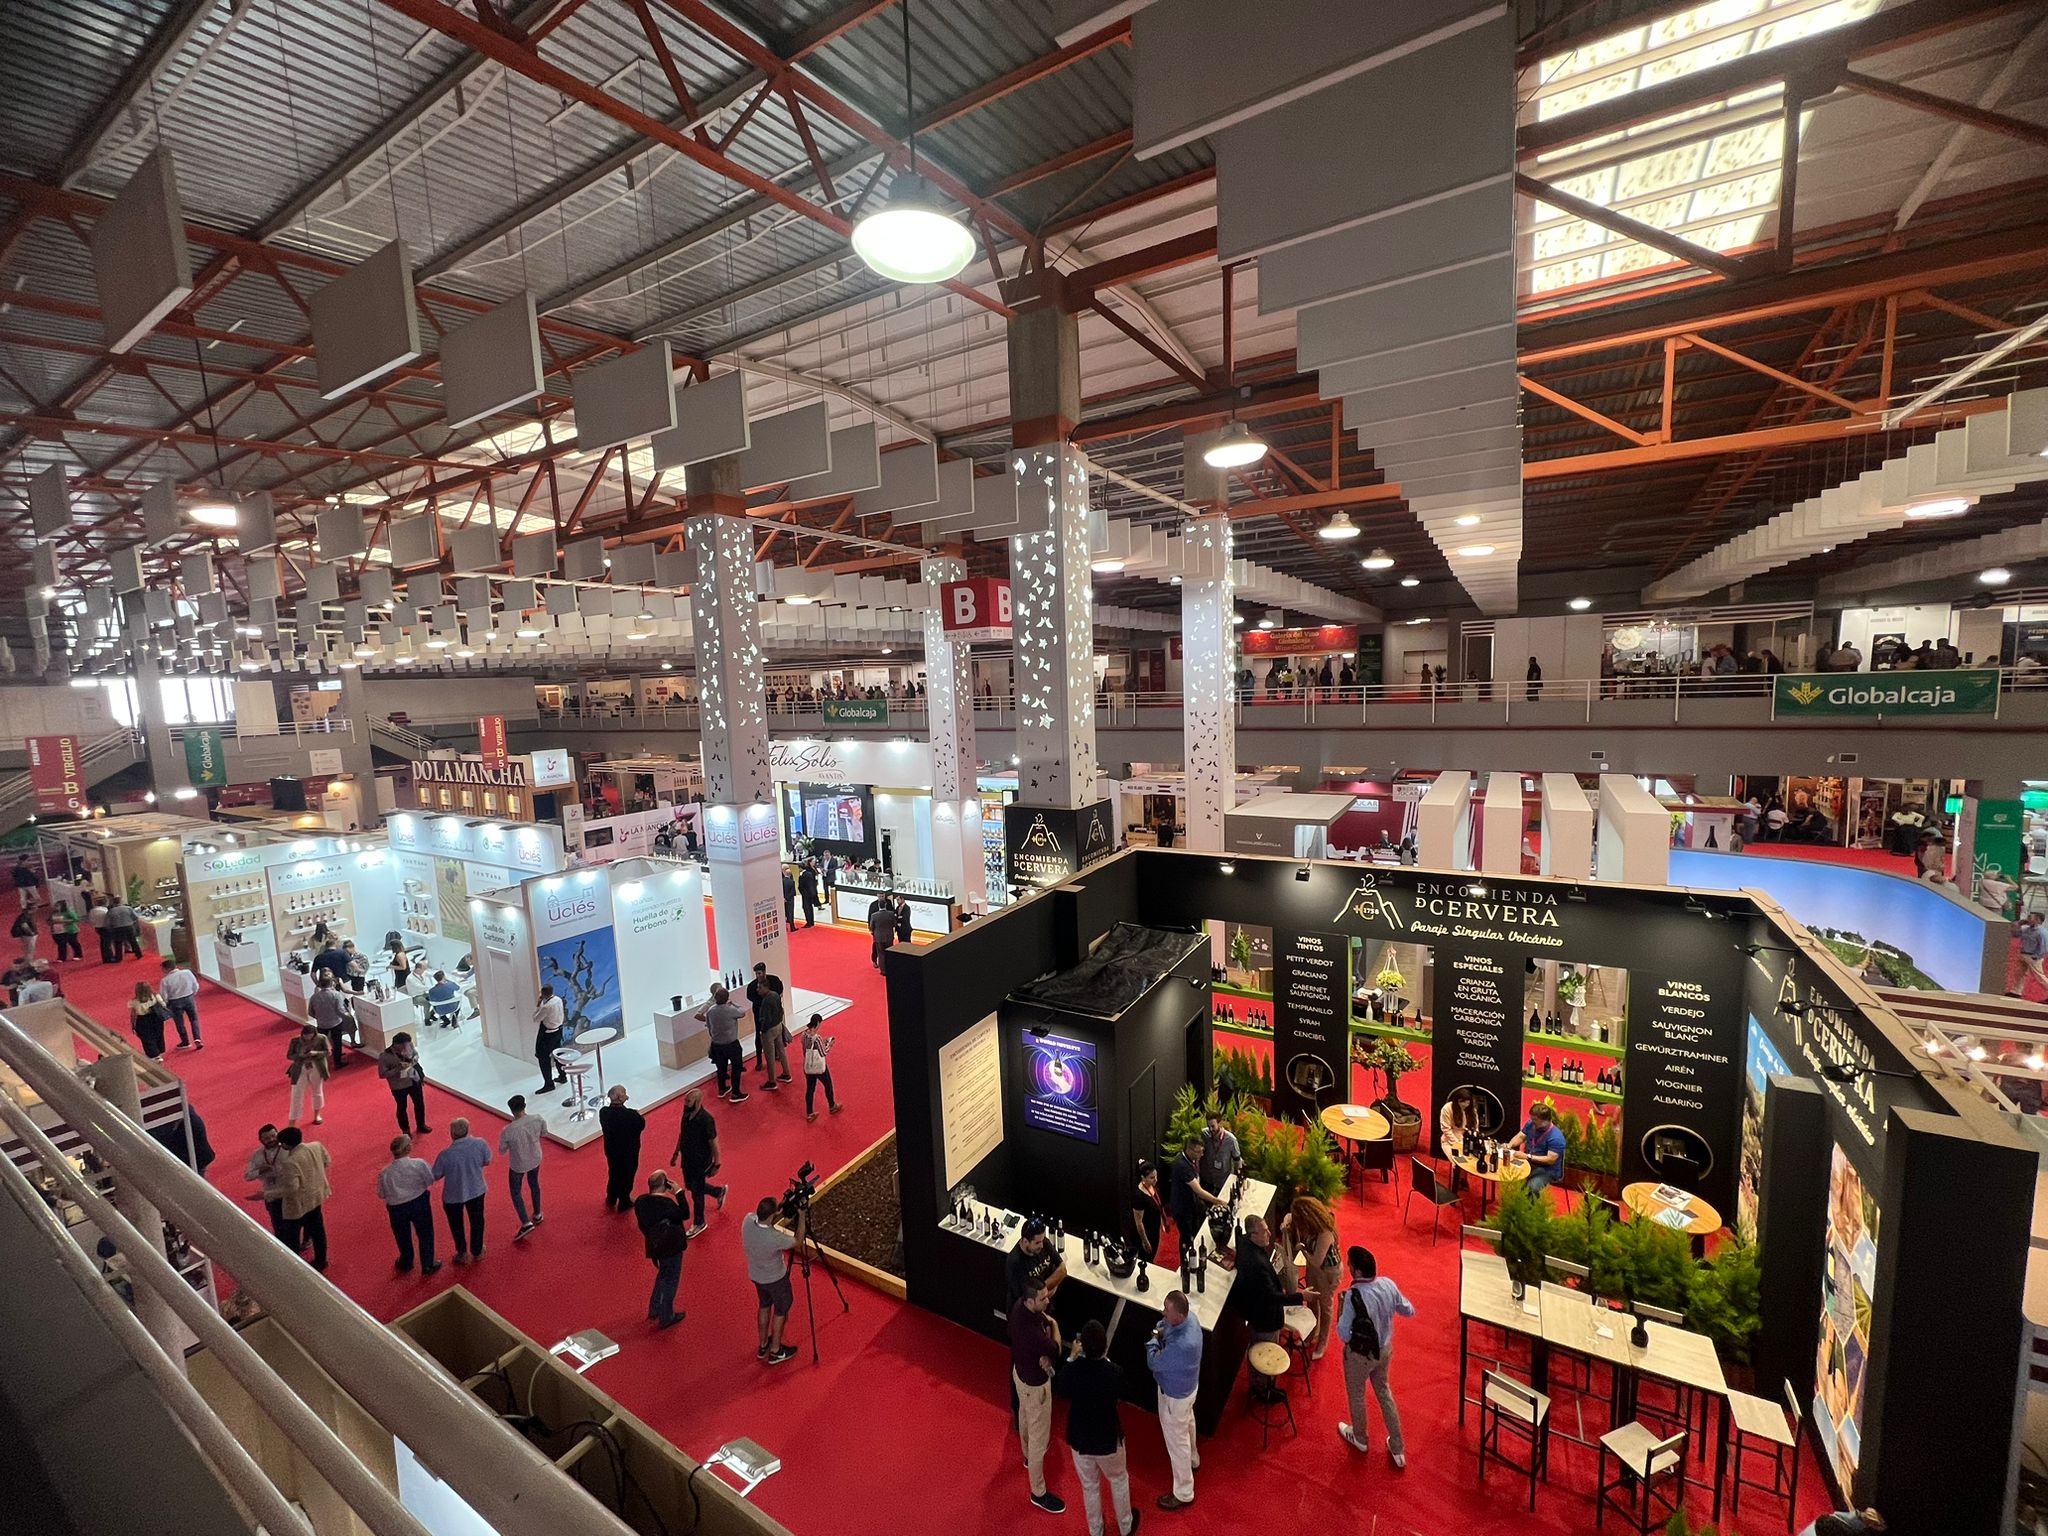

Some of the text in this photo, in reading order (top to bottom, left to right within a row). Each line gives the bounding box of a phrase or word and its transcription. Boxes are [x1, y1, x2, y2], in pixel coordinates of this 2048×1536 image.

[953, 586, 977, 625] B
[997, 585, 1012, 623] B
[1828, 685, 1956, 707] Globalcaja
[839, 706, 877, 719] Globalcaja
[494, 716, 503, 746] VIRGILIO
[201, 731, 213, 769] Globalcaja
[60, 737, 77, 778] VIRGILIO
[63, 781, 80, 795] B
[68, 797, 80, 809] 6
[708, 830, 738, 845] Uclés
[743, 825, 778, 844] Uclés
[1013, 853, 1069, 865] ENCOMIENDA
[1019, 861, 1070, 876] CERVERA
[1417, 882, 1558, 906] ENCOIENDA
[548, 899, 595, 922] Uclés
[632, 909, 669, 924] Huella de
[1429, 899, 1559, 928] CERVERA
[633, 919, 668, 934] Carbono
[1297, 936, 1322, 945] VINOS
[1410, 920, 1564, 948] Paraje Singular Volcánico
[1296, 942, 1324, 952] TINTOS
[1286, 955, 1334, 967] PETIT VERDOT
[1464, 955, 1493, 965] VINOS
[1291, 969, 1328, 980] GRACIANO
[1453, 961, 1504, 974] ESPECIALES
[1292, 983, 1328, 994] CABERNET
[1459, 977, 1497, 988] CRIANZA
[1666, 980, 1702, 992] VINOS
[1290, 989, 1331, 1001] SAUVIGNON
[1453, 991, 1503, 1004] VOLCÁNICA
[1457, 984, 1499, 997] EN GRUTA
[1658, 988, 1711, 1002] BLANCOS
[1287, 1002, 1333, 1016] TEMPRANILLO
[1450, 1006, 1505, 1020] MACERACIÓN
[1661, 1005, 1705, 1019] VERDEJO
[1299, 1017, 1321, 1027] SYRAH
[1453, 1014, 1502, 1027] CARBÓNICA
[1456, 1029, 1499, 1041] RECOGIDA
[1652, 1020, 1713, 1036] SAUVIGNON
[1809, 985, 1876, 1076] ENCOMIENDA
[1293, 1030, 1327, 1042] CENCIBEL
[1463, 1037, 1493, 1048] TARDÍA
[1664, 1031, 1699, 1043] BLANC
[1459, 1052, 1496, 1064] CRIANZA
[1635, 1042, 1729, 1064] GEWÜRZTRAMINER
[1456, 1059, 1500, 1072] OXIDATIVA
[1664, 1064, 1695, 1075] AIRÉN
[1655, 1078, 1704, 1093] VIOGNIER
[1652, 1094, 1704, 1110] ALBARIÑO
